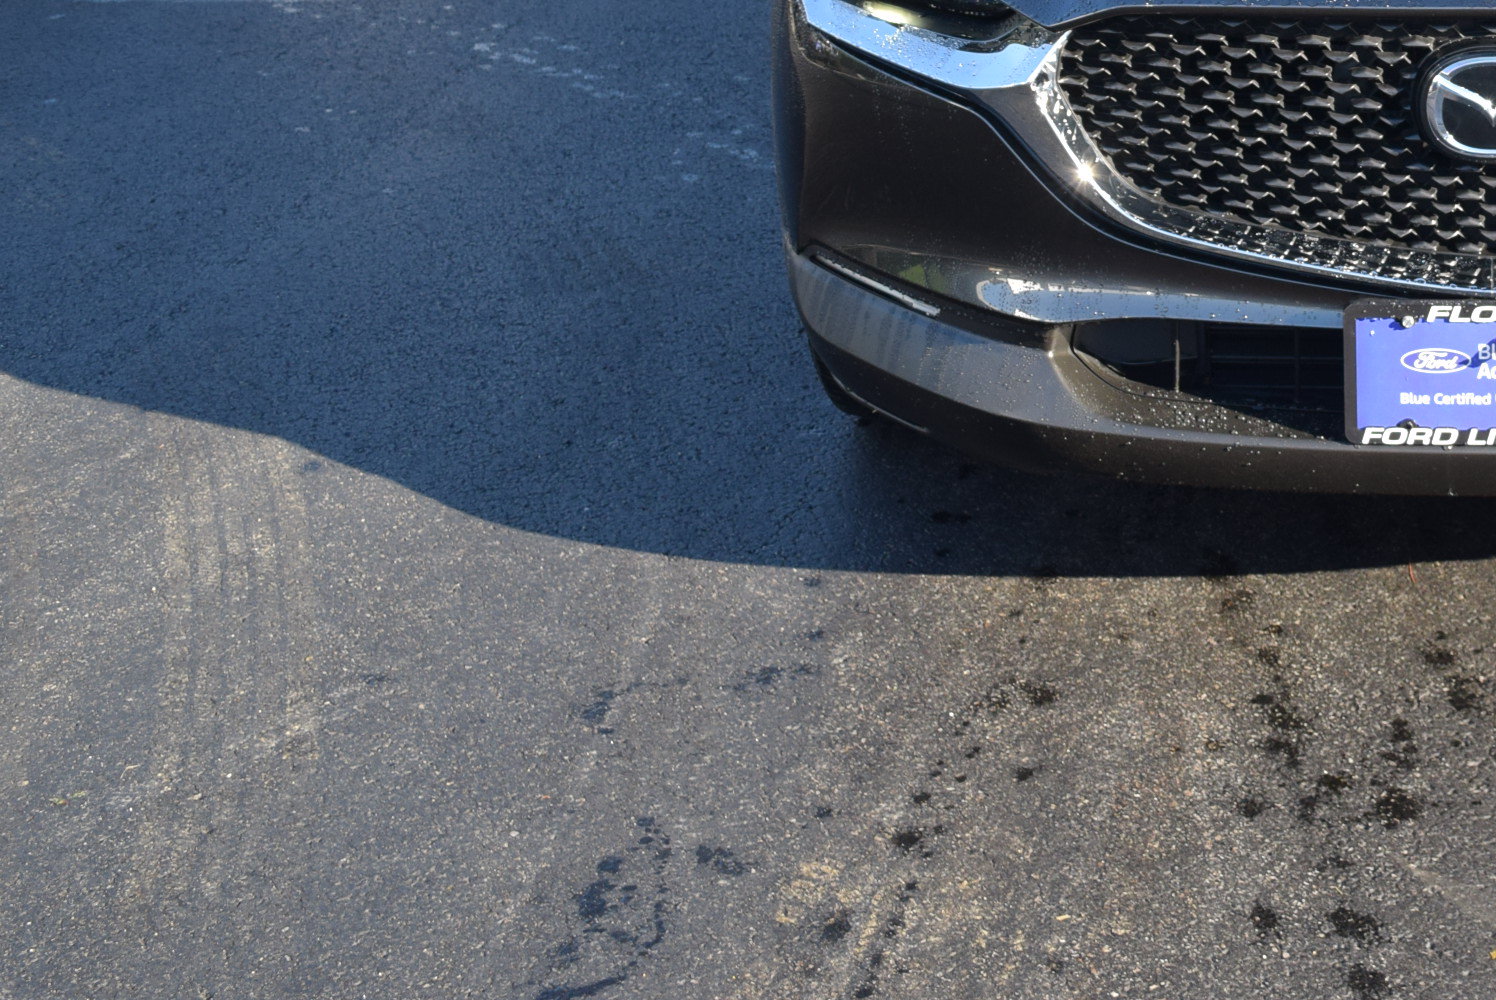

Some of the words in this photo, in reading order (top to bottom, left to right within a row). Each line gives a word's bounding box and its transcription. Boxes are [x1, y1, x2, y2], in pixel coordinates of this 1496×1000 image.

[1413, 351, 1460, 370] Ford
[1400, 392, 1431, 405] Blue
[1433, 392, 1492, 405] Certified
[1361, 426, 1466, 446] FORD
